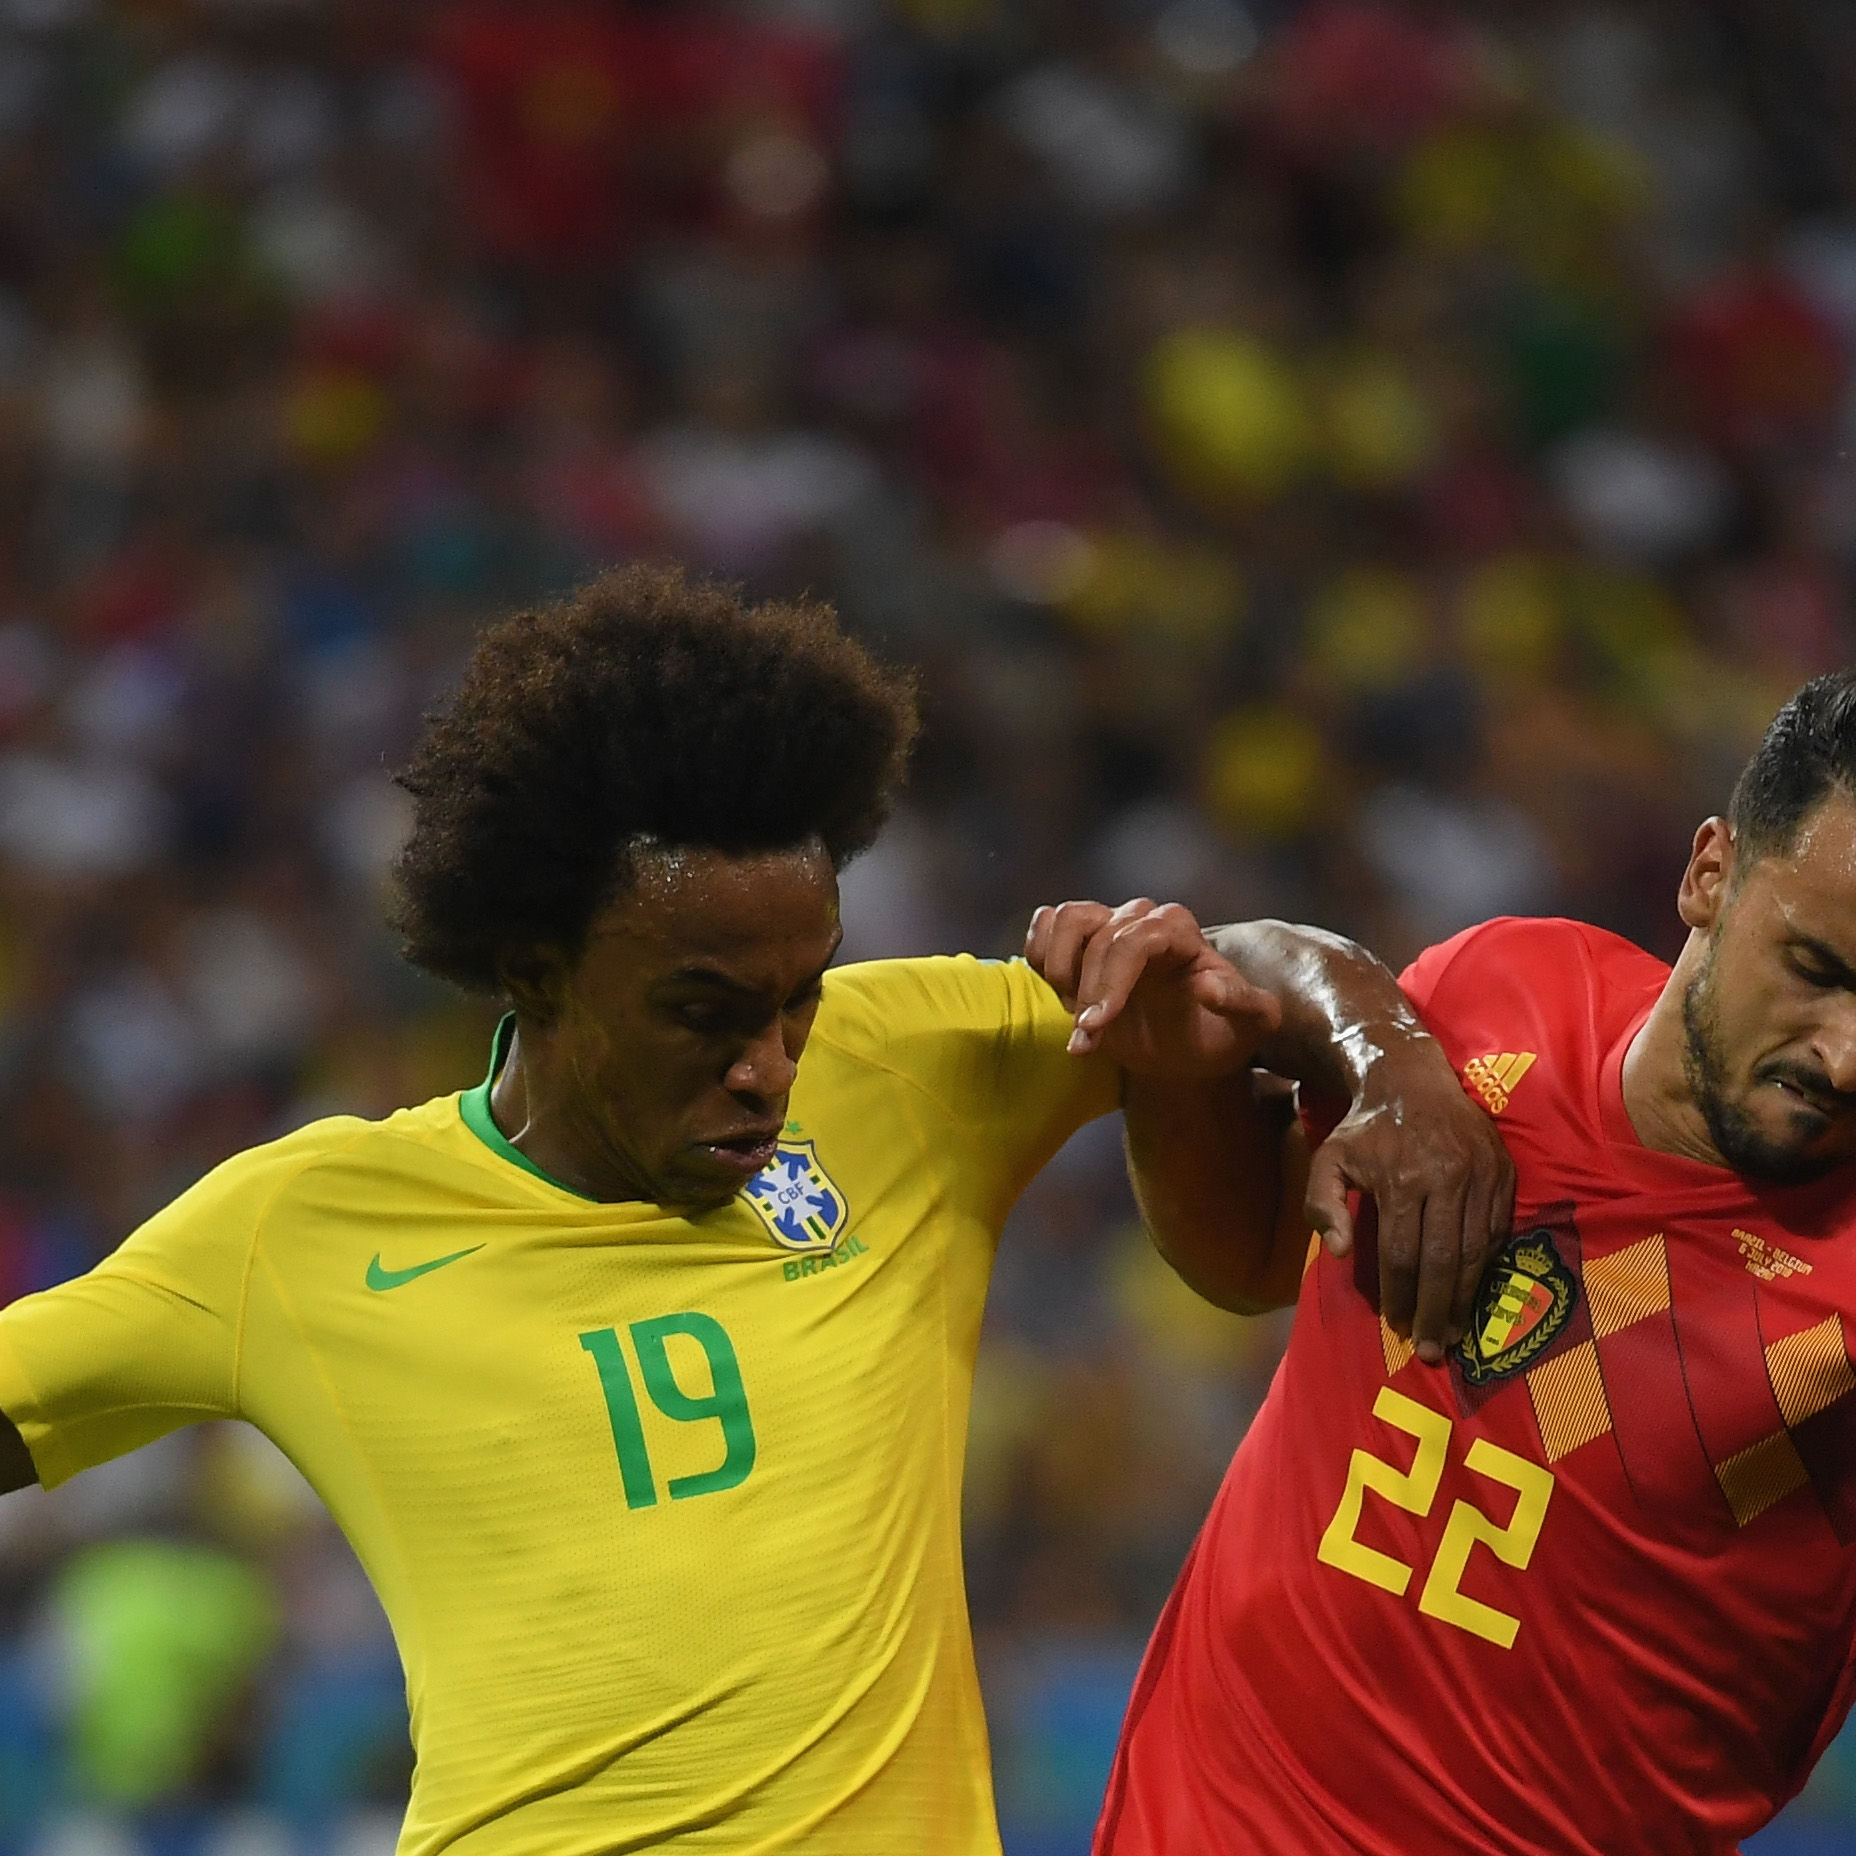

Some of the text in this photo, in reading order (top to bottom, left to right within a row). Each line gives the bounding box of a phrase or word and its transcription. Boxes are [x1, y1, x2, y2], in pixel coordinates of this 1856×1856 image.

[1464, 1057, 1509, 1114] adidas
[777, 1181, 805, 1205] CBF
[783, 1235, 869, 1282] BRASIL
[578, 1311, 757, 1510] 19
[1317, 1386, 1555, 1650] 22
